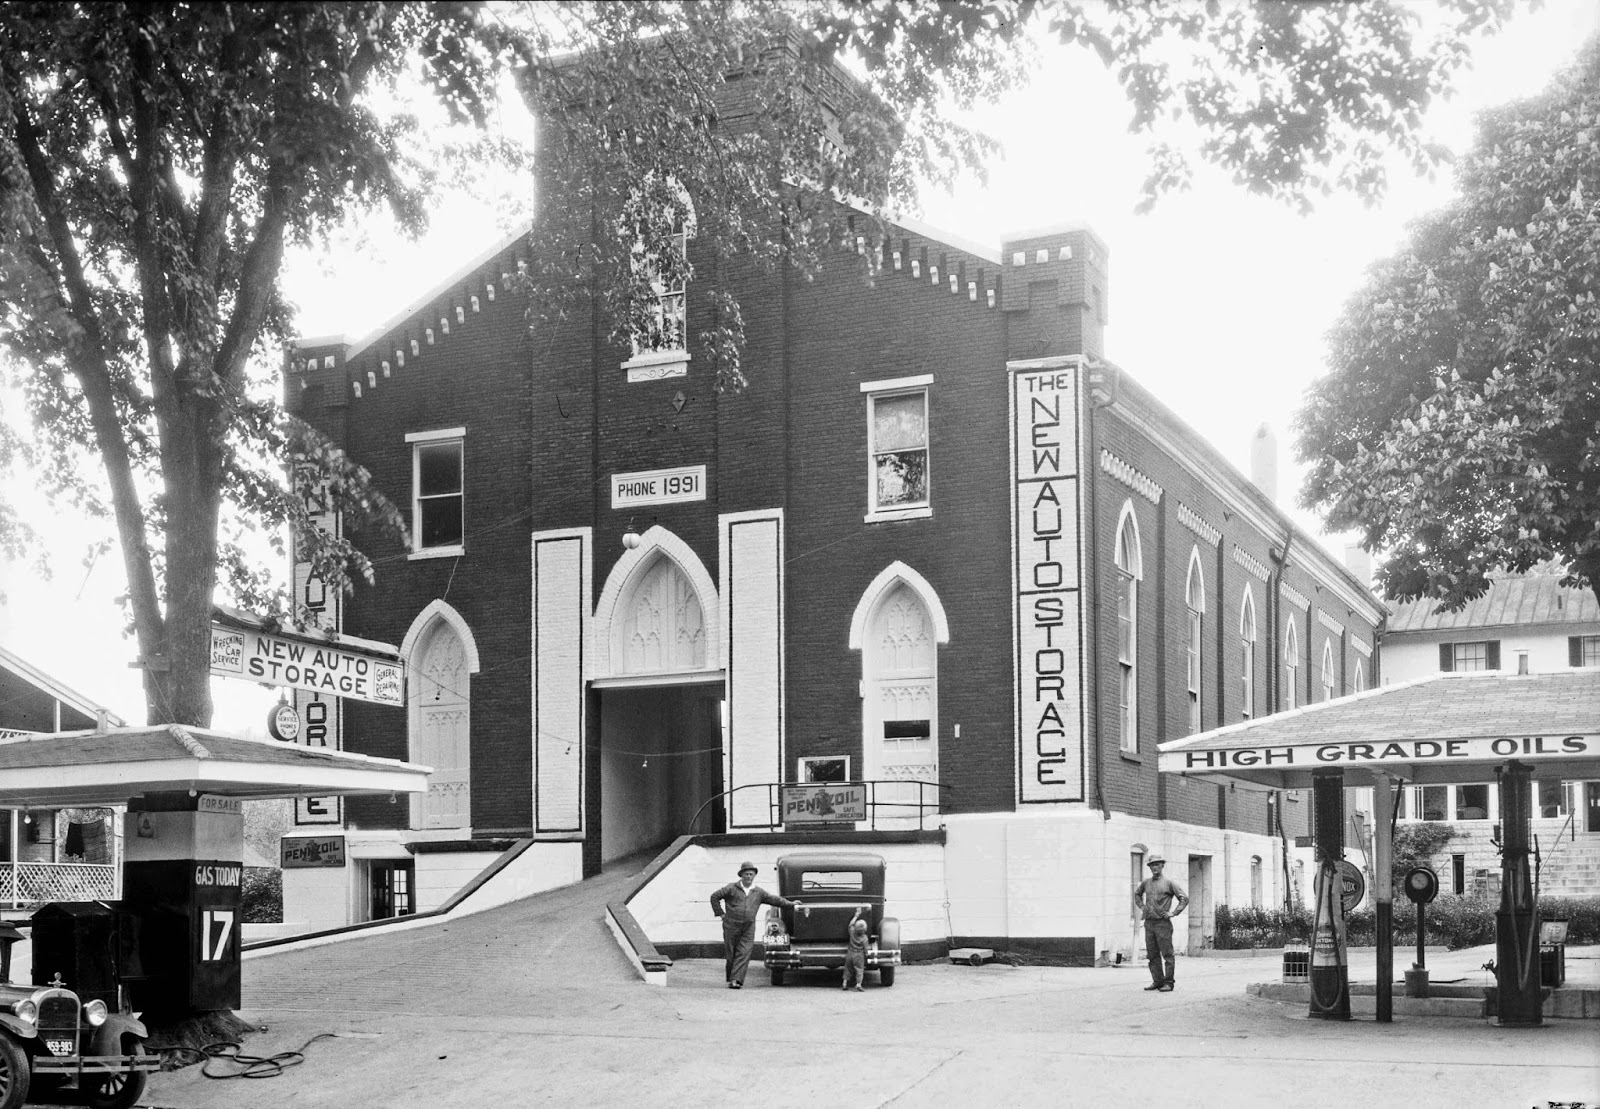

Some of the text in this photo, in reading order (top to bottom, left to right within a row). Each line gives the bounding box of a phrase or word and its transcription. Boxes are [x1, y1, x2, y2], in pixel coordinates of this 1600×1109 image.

[1025, 374, 1068, 392] THE
[1031, 394, 1060, 474] NEW
[618, 475, 698, 497] PHONE 1991
[1033, 481, 1062, 588] AUTO
[305, 563, 326, 628] AUT
[213, 635, 242, 649] WRECKING
[226, 646, 241, 656] CAR
[213, 651, 239, 665] SERVICE
[257, 637, 368, 676] NEW AUTO
[249, 657, 367, 695] STORAGE
[376, 668, 398, 682] GENERAL
[1035, 598, 1066, 784] STORAGE
[1186, 736, 1587, 768] HIGH GRADE OILS
[202, 799, 239, 811] FOR SALE
[195, 866, 241, 887] GAS TODAY
[202, 911, 233, 961] 17
